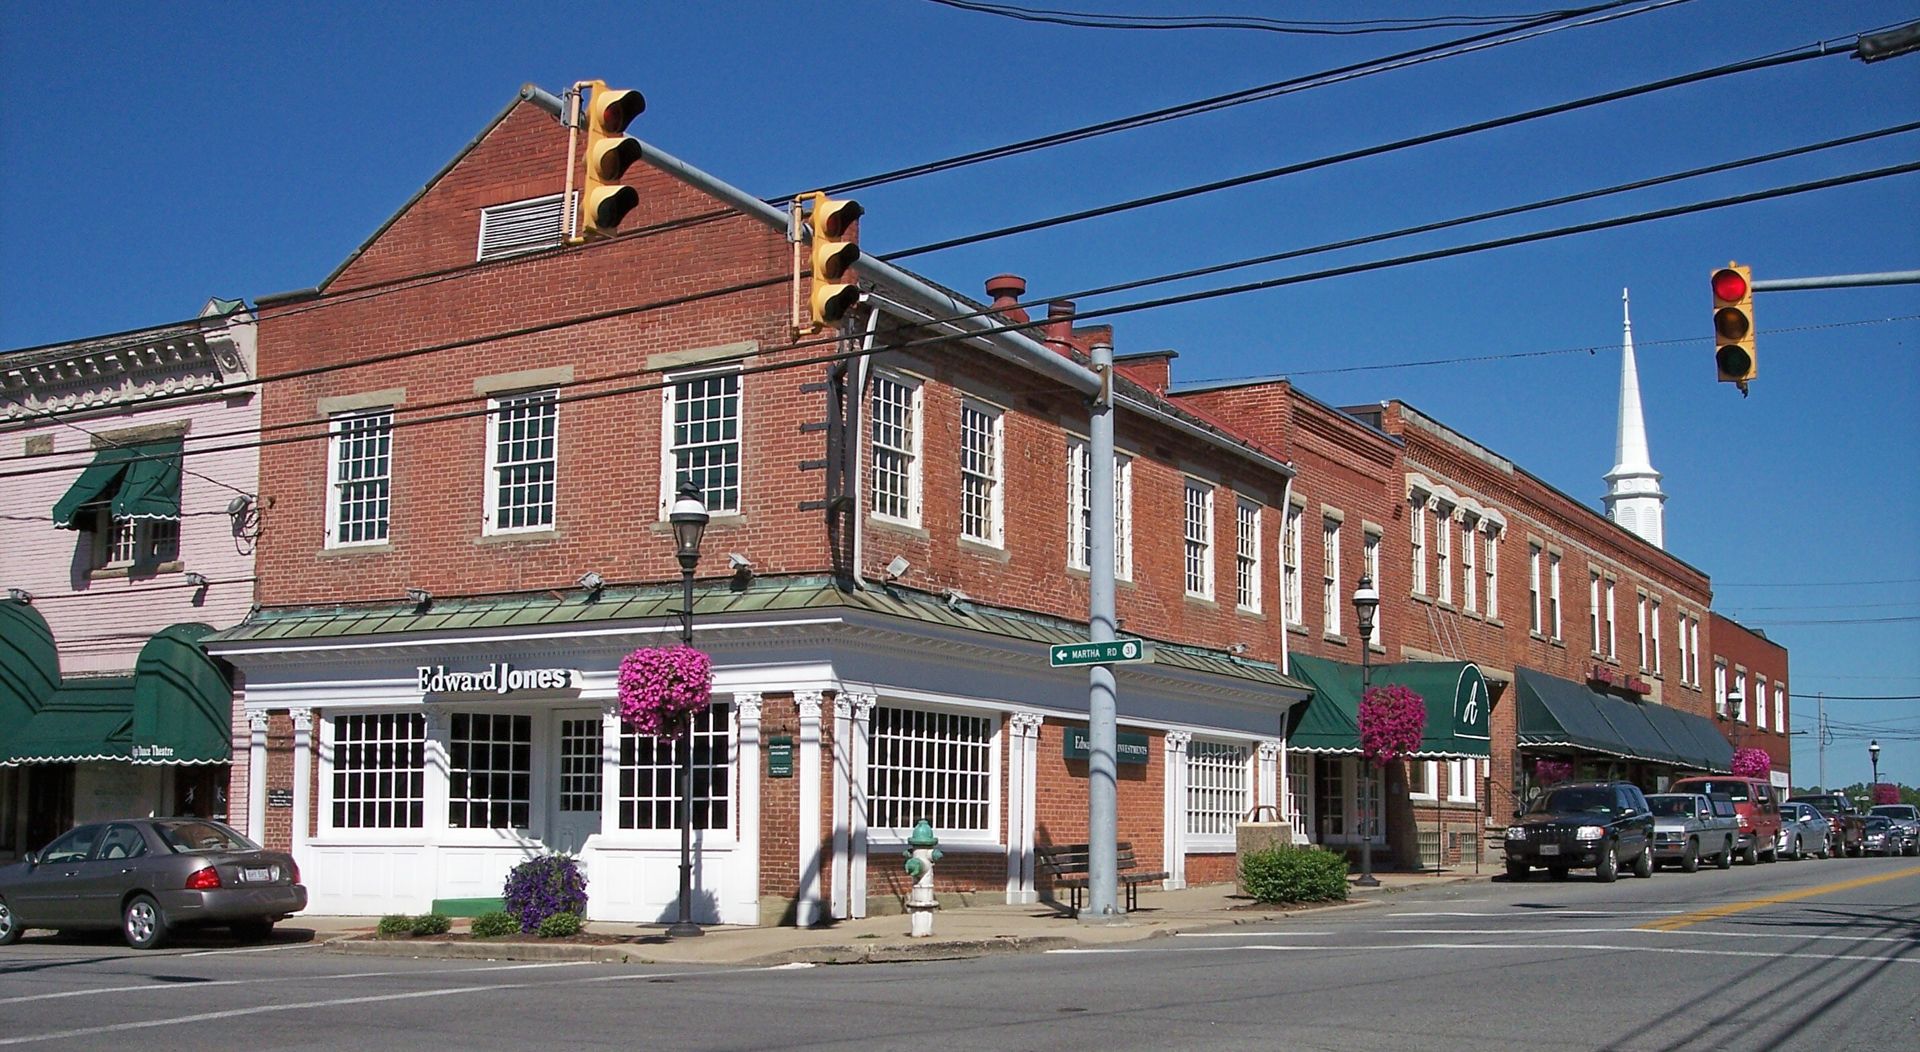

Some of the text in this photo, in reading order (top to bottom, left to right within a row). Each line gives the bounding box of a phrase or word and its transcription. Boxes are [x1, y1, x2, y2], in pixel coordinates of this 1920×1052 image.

[1072, 646, 1133, 659] MARTHA RD 31
[416, 662, 567, 694] Edward Jones
[151, 744, 174, 756] Theatre
[1074, 735, 1148, 755] Edwa INVESTMENTS
